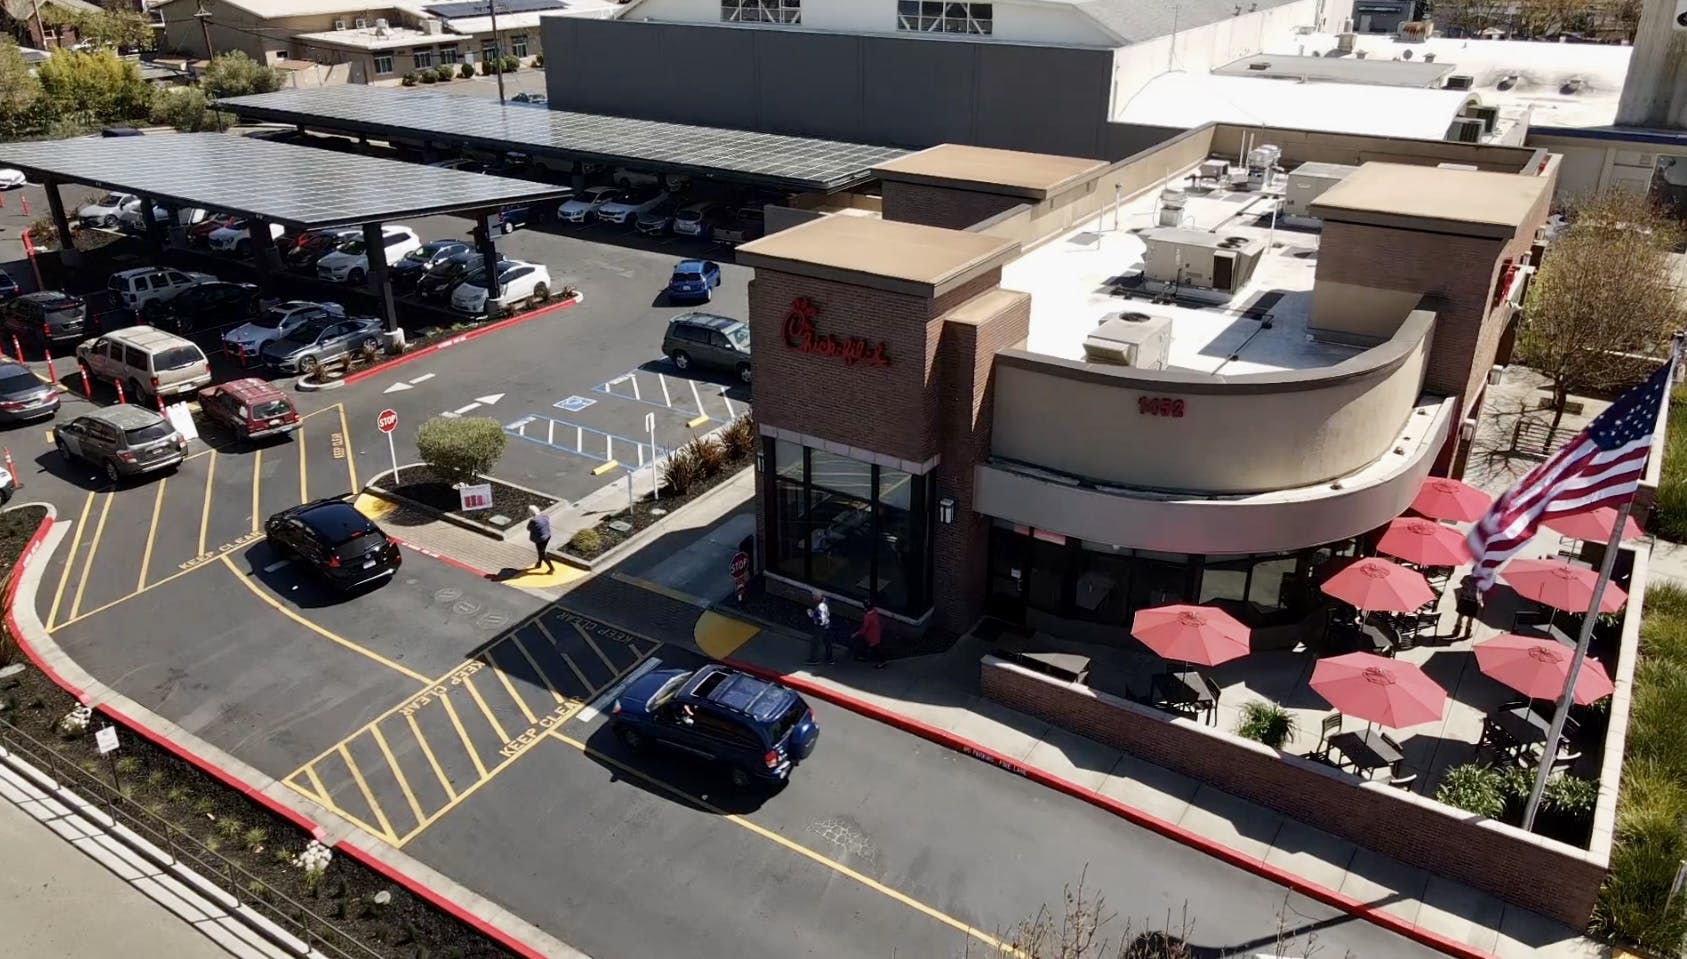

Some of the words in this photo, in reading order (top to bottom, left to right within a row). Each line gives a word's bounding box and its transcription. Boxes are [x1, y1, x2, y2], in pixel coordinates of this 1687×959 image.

[380, 414, 396, 428] STOP
[330, 432, 343, 446] CLEAR
[333, 447, 345, 459] KEEP
[178, 551, 214, 570] KEEP
[219, 530, 267, 552] CLEAR
[731, 558, 749, 574] STOP
[556, 611, 598, 632] CLEAR
[598, 629, 634, 645] KEEP
[450, 660, 486, 685] KEEP
[399, 685, 448, 716] CLEAR
[499, 727, 537, 758] KEEP
